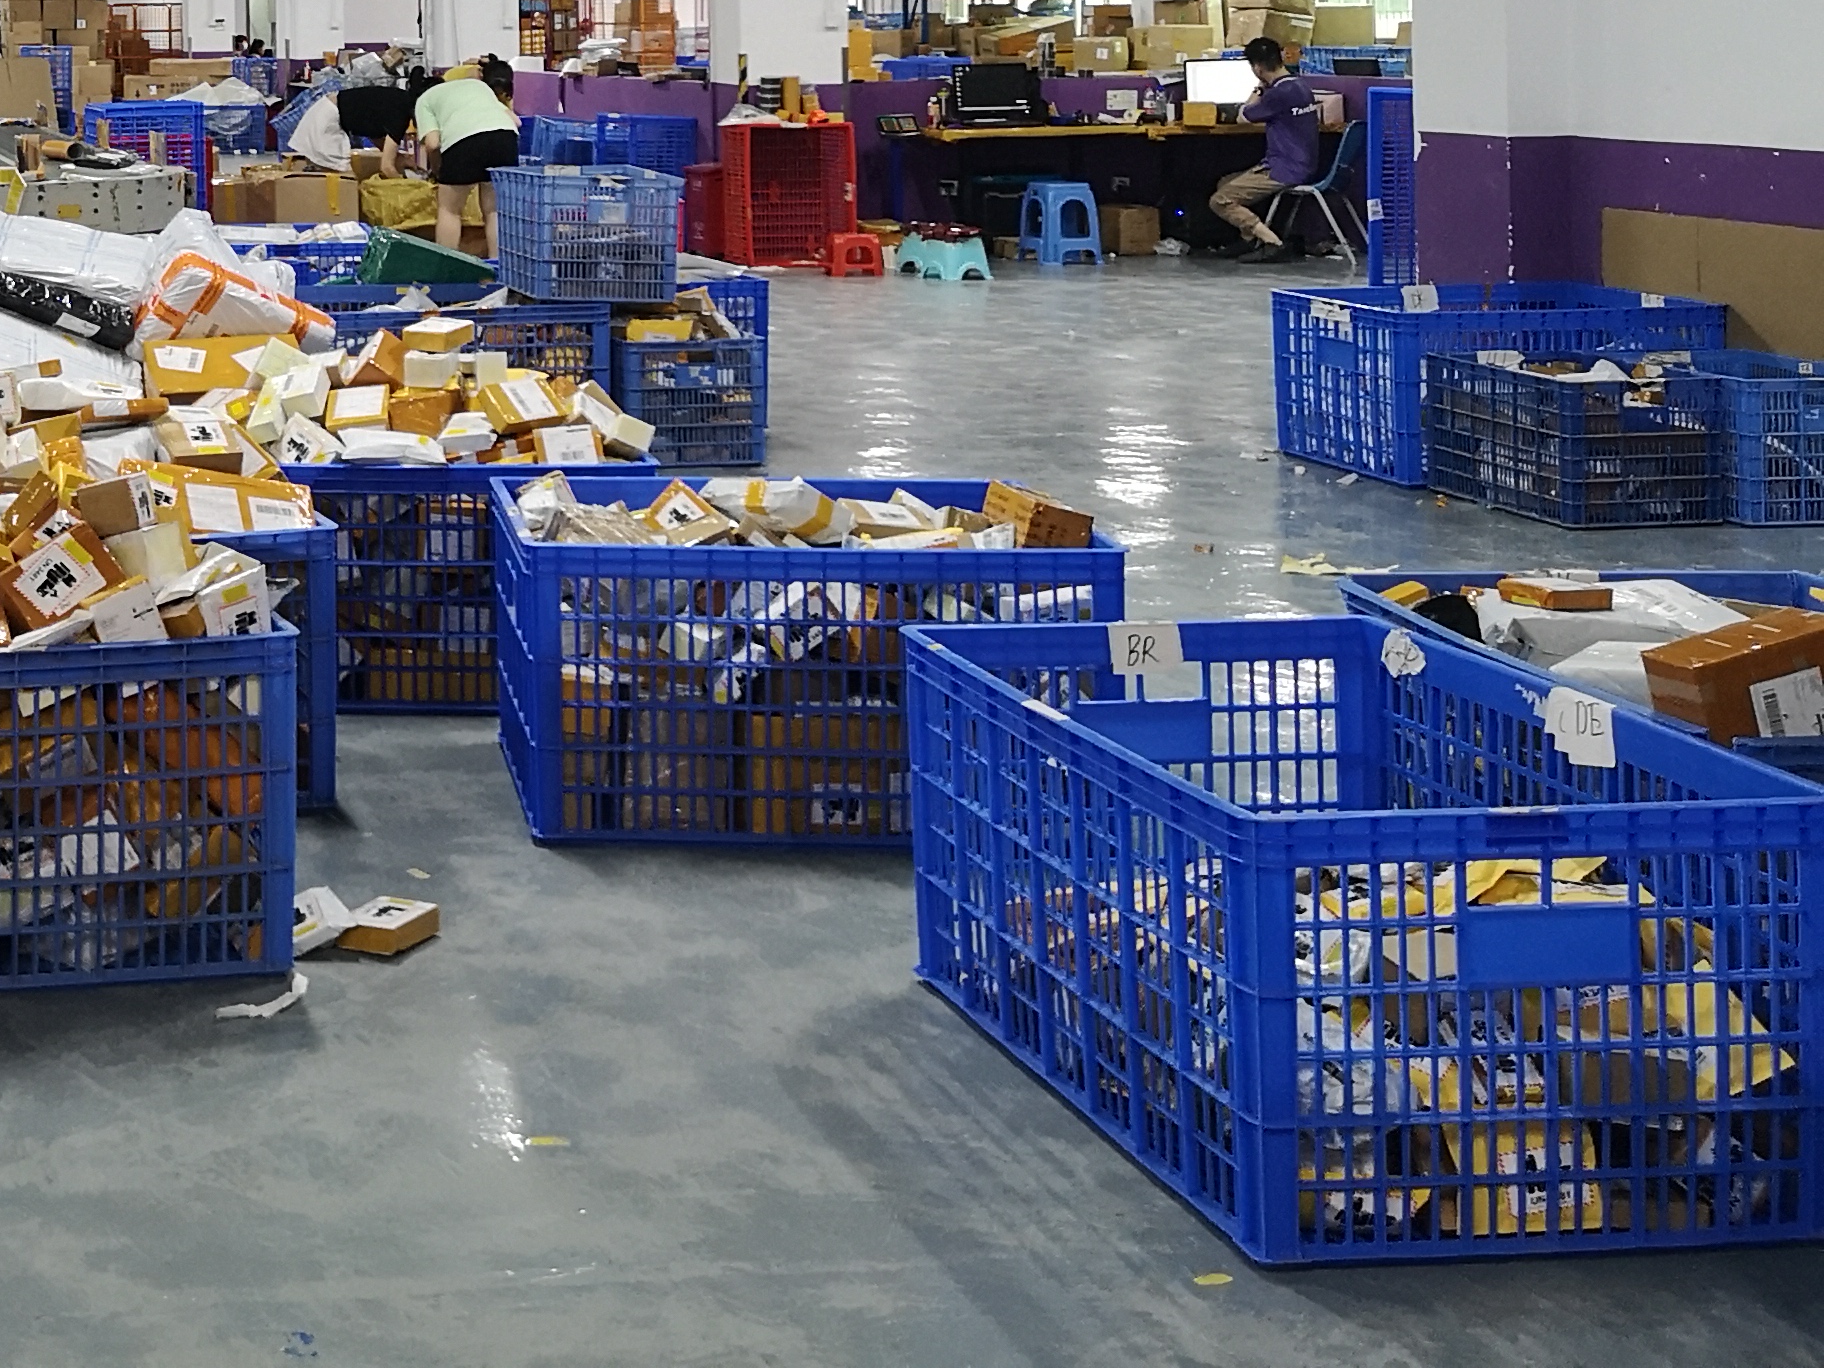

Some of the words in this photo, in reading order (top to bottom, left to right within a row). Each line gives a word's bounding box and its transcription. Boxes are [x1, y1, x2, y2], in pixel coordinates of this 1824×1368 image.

[42, 558, 53, 567] UN
[29, 566, 44, 582] 3481
[1127, 634, 1160, 667] BR
